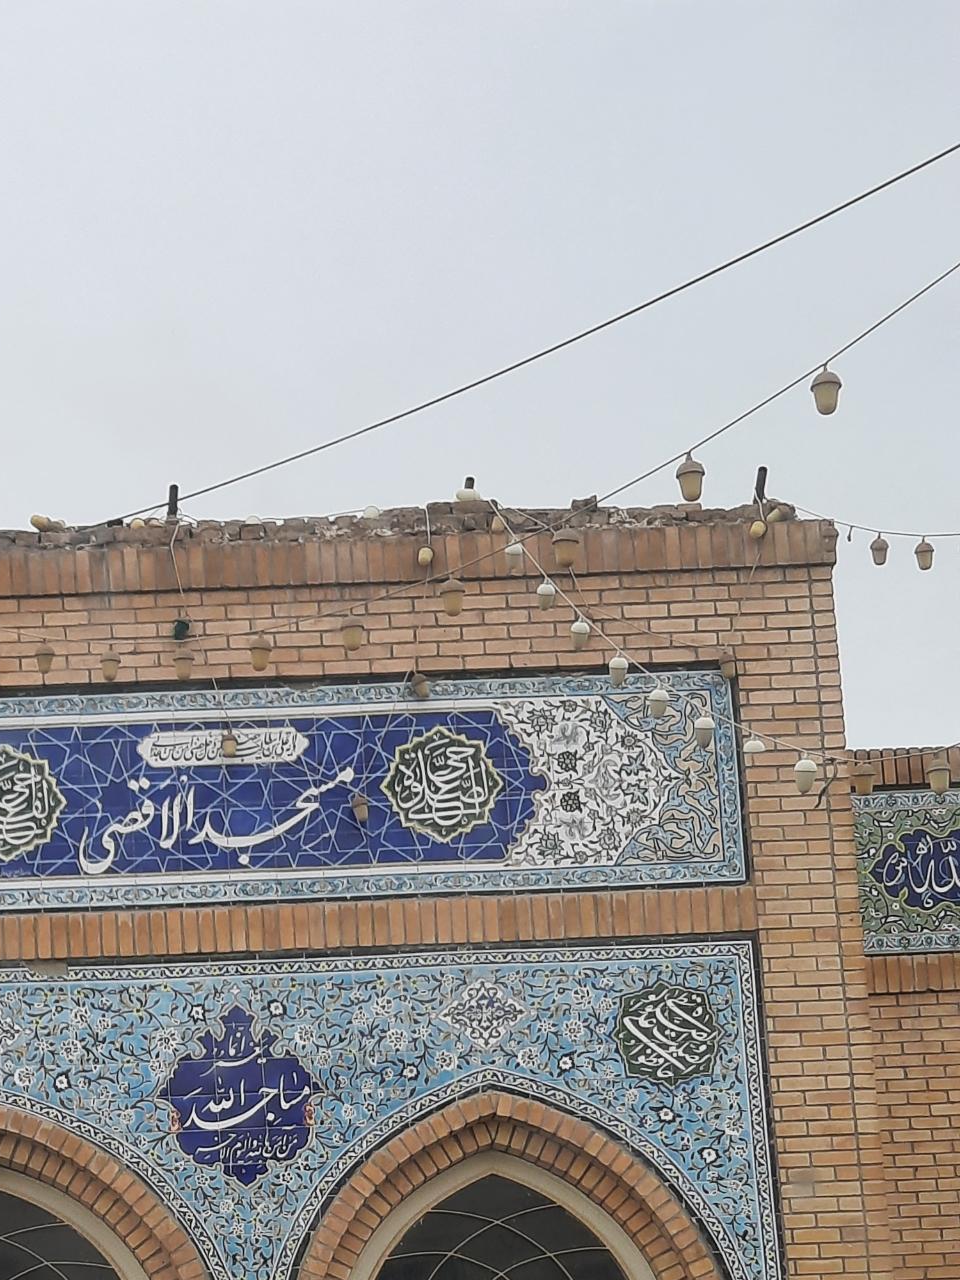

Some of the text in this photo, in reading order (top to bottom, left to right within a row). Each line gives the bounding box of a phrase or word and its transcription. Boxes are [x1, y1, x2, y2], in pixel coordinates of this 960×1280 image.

[188, 766, 354, 865] مسجد
[183, 1074, 310, 1130] مساجد الله
